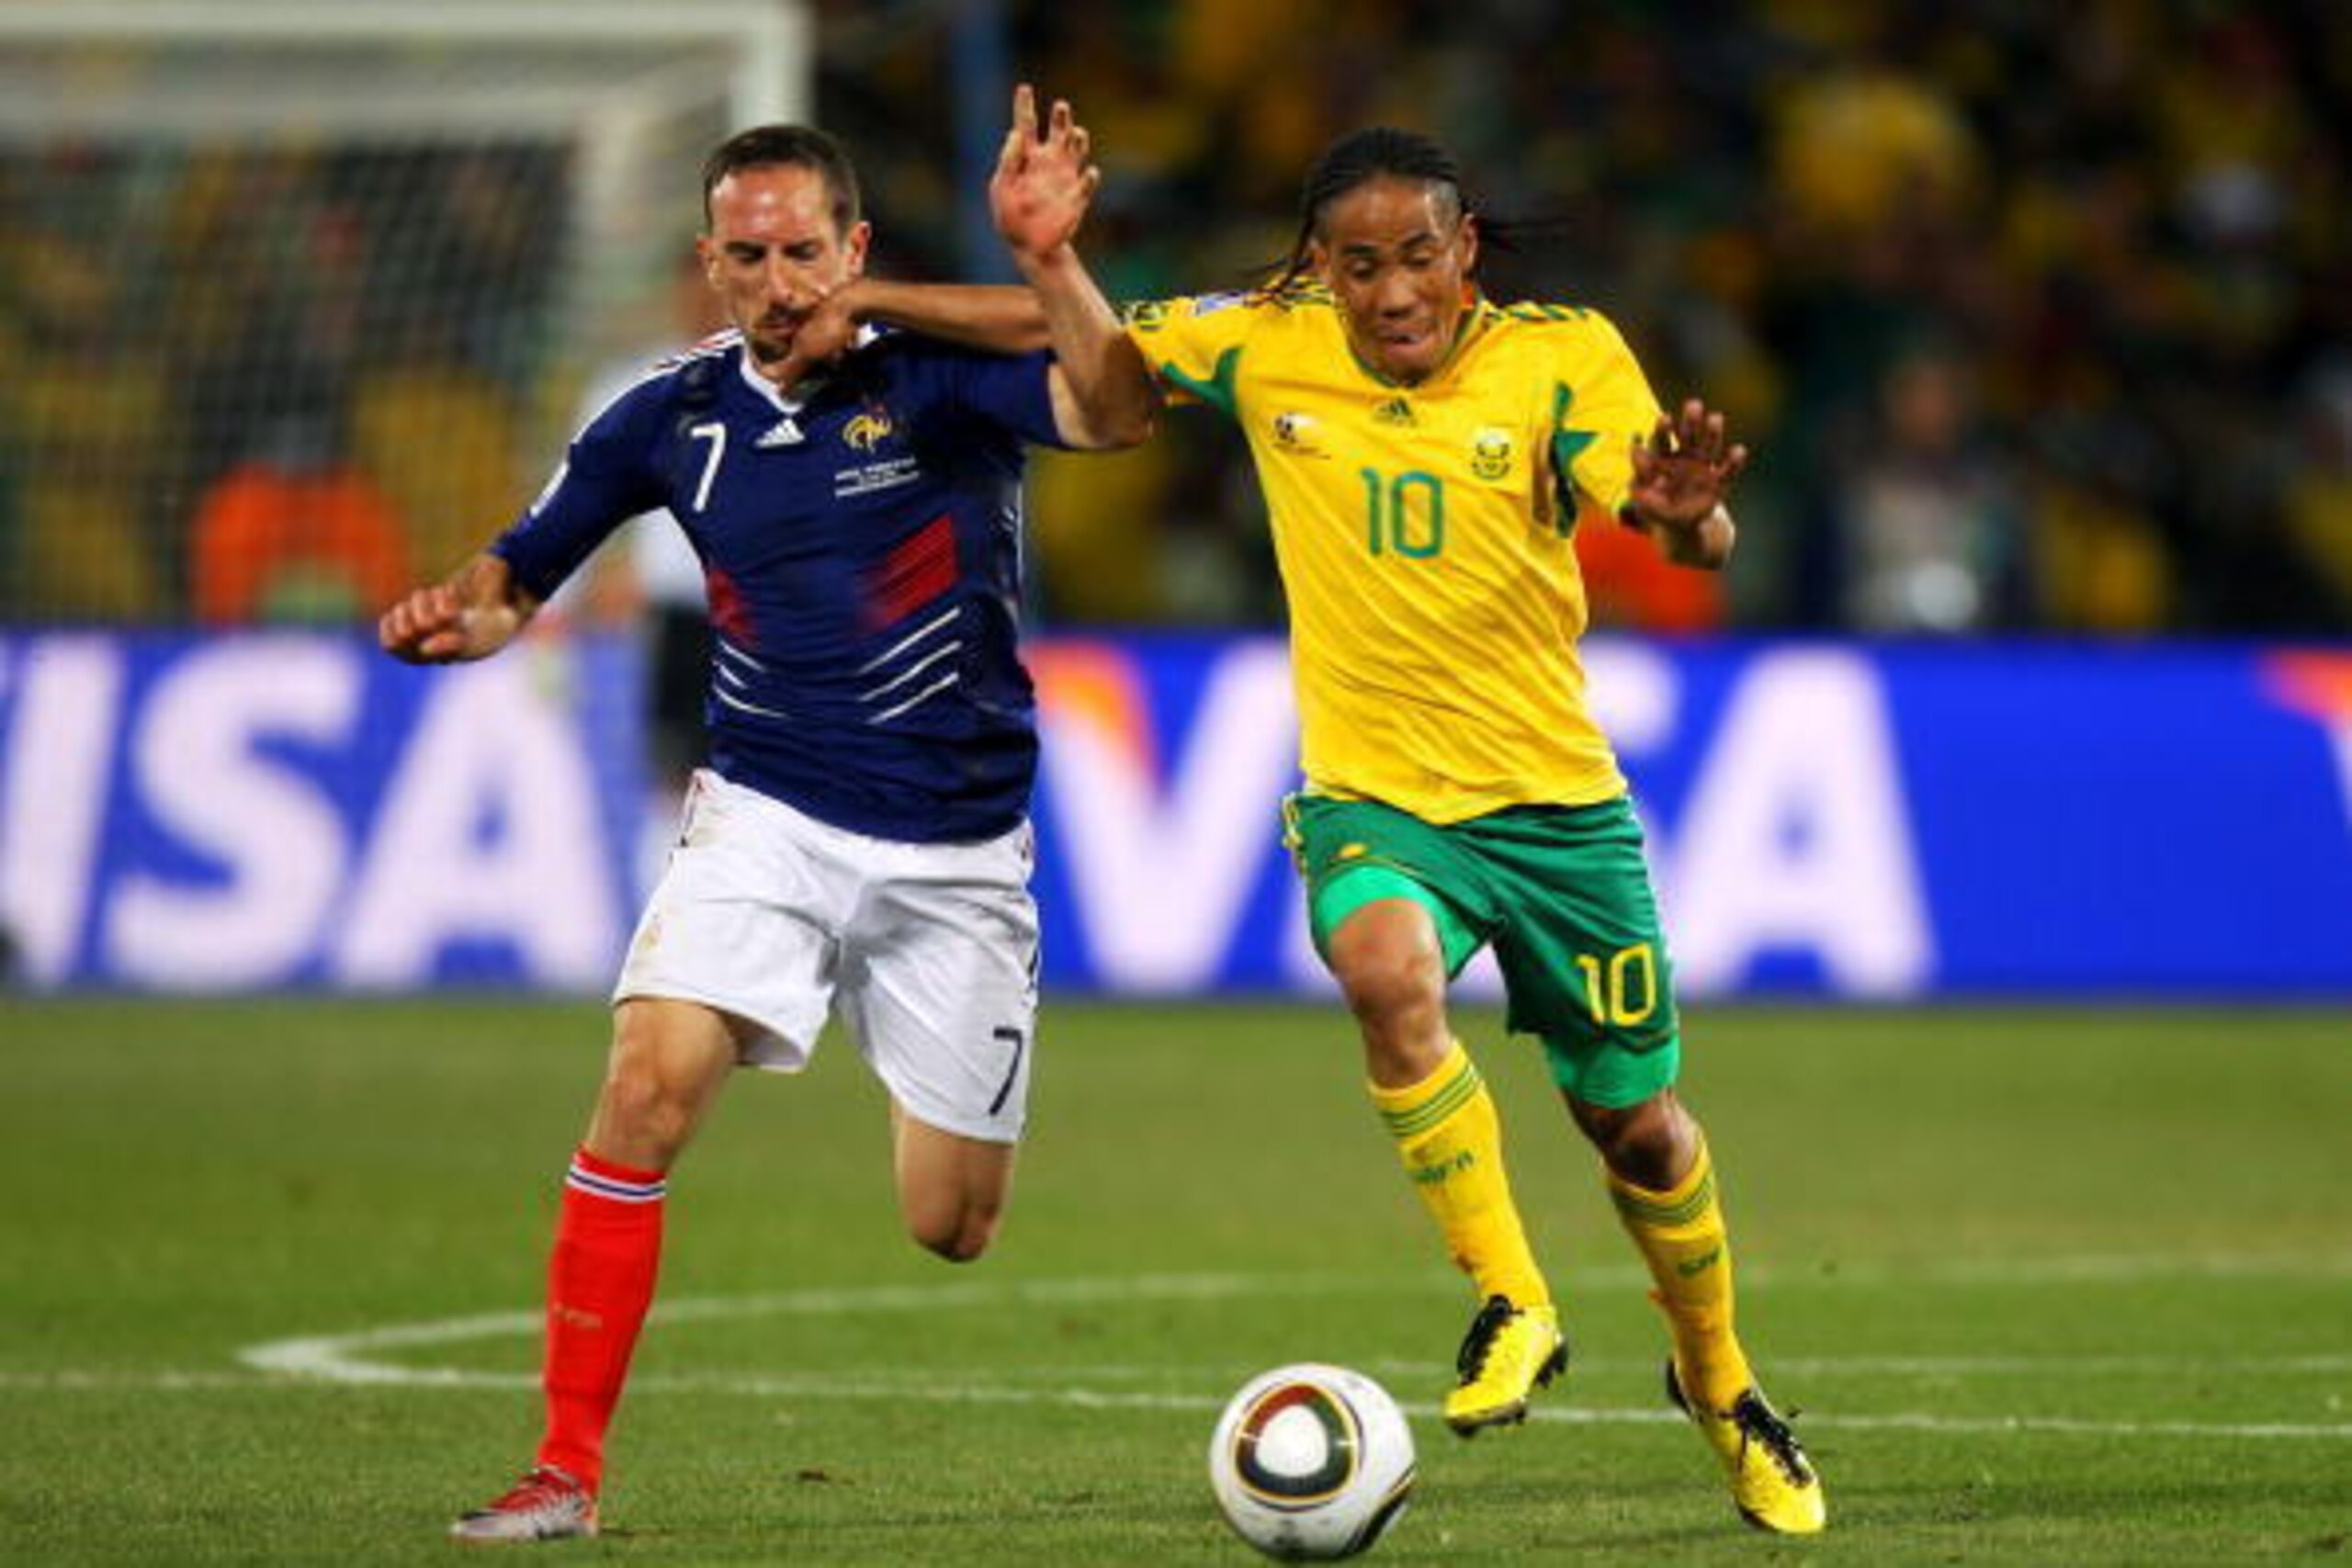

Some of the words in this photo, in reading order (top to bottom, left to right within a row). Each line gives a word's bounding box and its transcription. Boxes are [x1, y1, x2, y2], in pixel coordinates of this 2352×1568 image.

[692, 423, 726, 512] 7
[1360, 467, 1444, 558] 10
[0, 634, 617, 994] ISA
[1577, 942, 1656, 1028] 10
[989, 1026, 1023, 1116] 7
